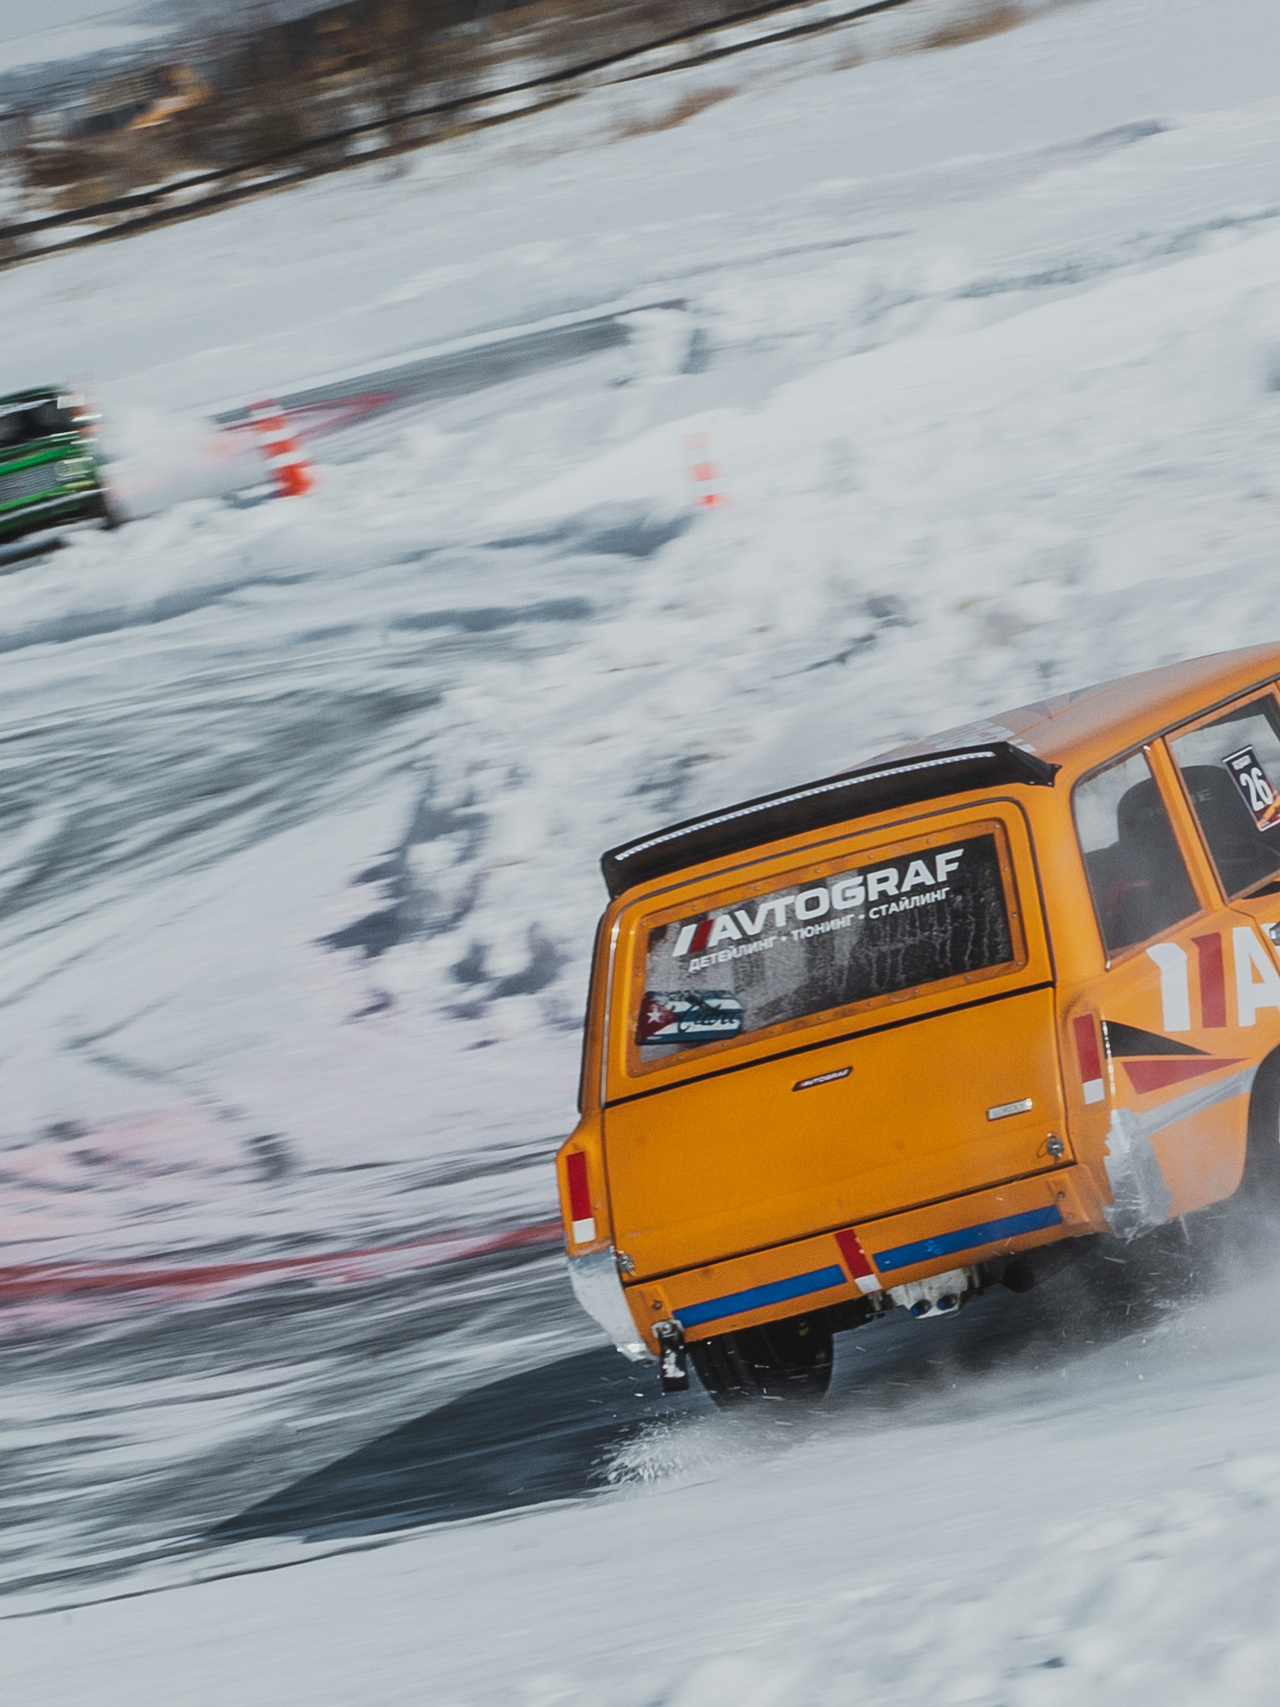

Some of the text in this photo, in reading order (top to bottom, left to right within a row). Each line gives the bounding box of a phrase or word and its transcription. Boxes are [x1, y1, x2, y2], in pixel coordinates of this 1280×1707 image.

[1239, 767, 1274, 811] 26
[688, 887, 950, 974] ДЕТЕЙЛИНГ ТЮНИНГ СТАЙЛИНГ
[707, 848, 965, 947] AVTOGRAF
